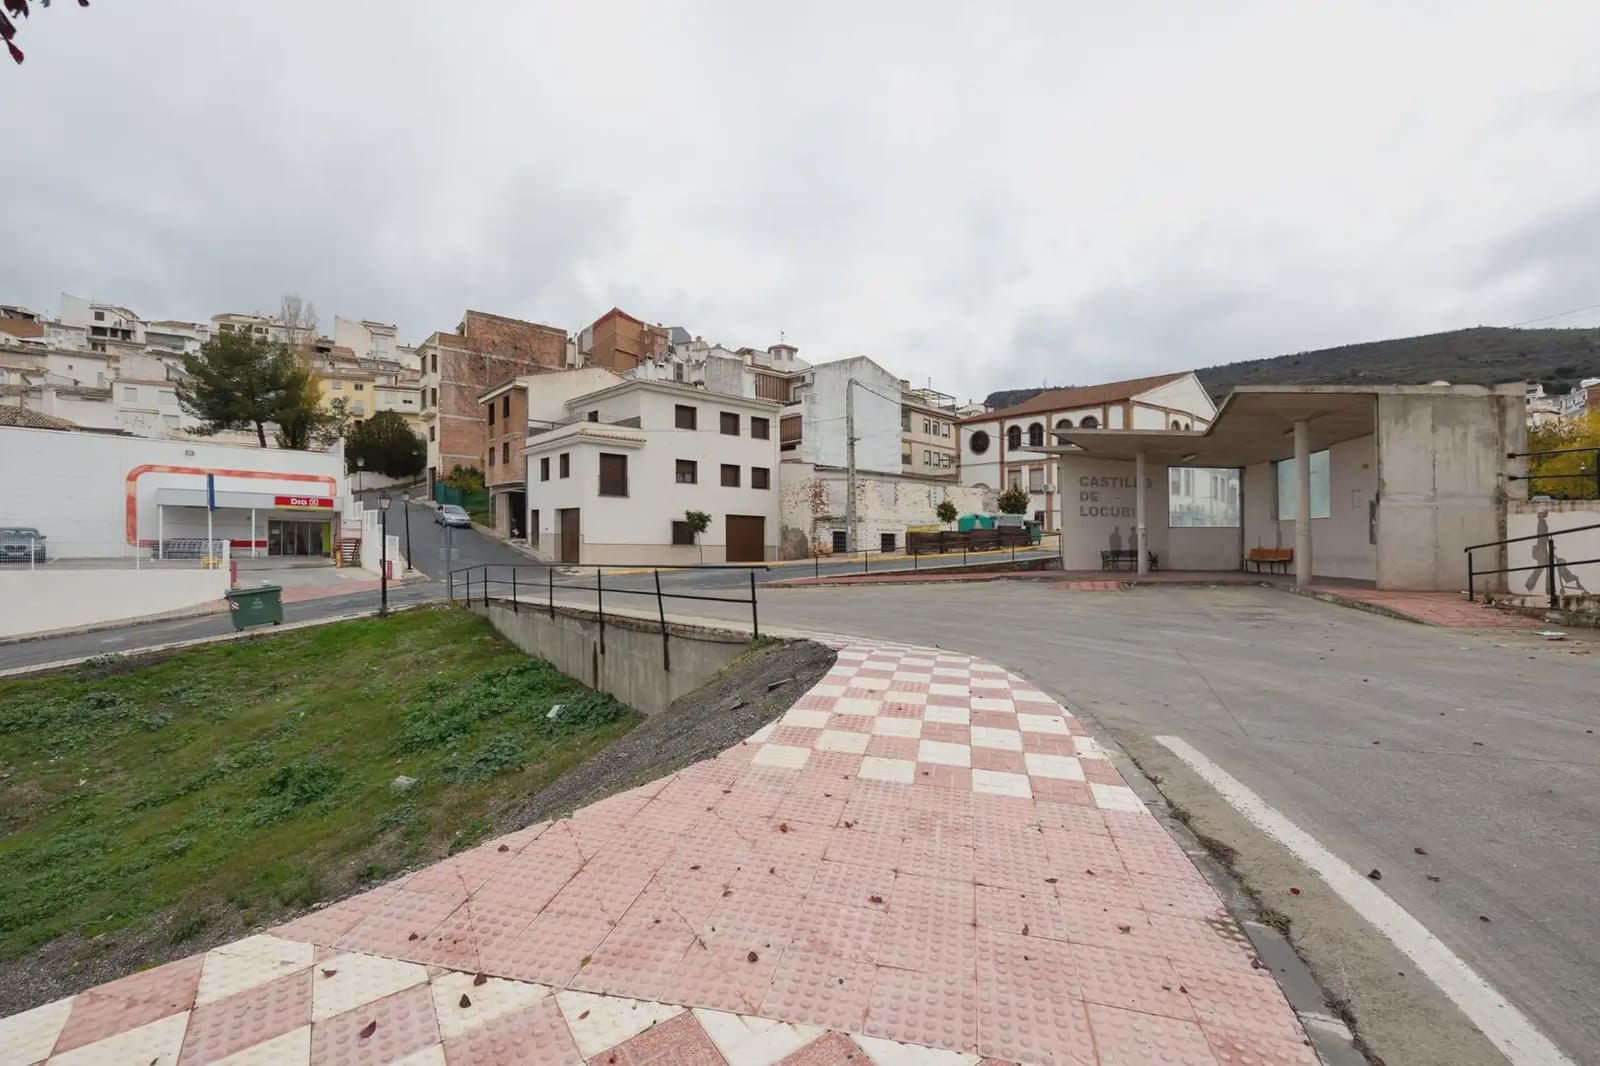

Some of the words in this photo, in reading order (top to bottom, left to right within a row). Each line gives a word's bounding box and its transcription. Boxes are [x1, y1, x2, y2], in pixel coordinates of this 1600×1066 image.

[290, 498, 308, 506] Dia
[1079, 491, 1099, 502] DE
[1079, 505, 1136, 518] LOCUBI
